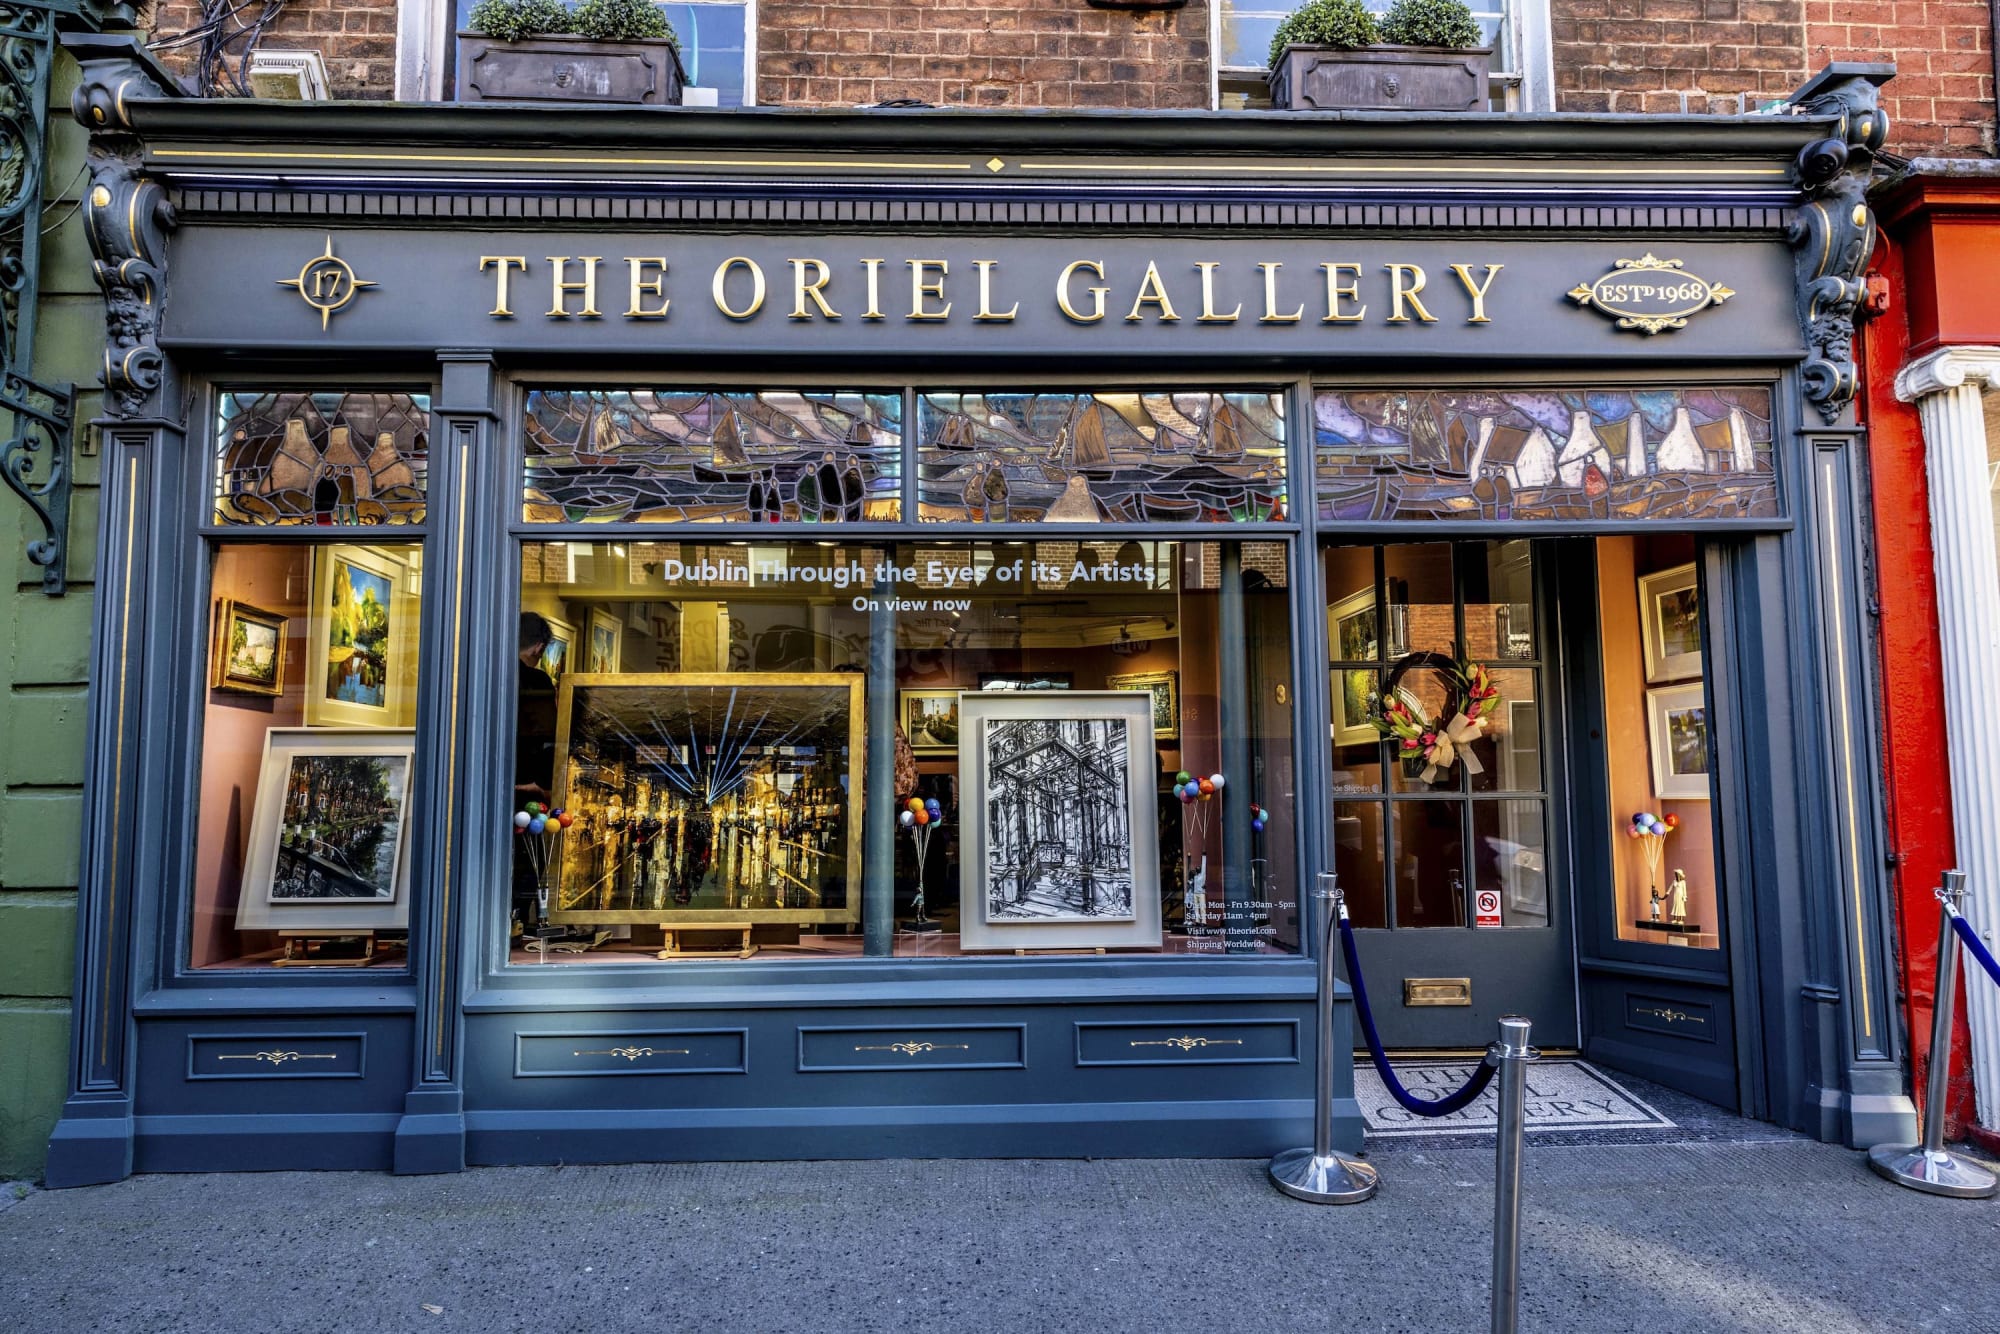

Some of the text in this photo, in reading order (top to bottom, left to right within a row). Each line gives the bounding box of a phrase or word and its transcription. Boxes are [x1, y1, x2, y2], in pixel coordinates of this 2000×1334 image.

[311, 269, 342, 298] 17
[479, 255, 1505, 323] THE ORIEL GALLERY
[1657, 282, 1704, 304] 1968
[664, 558, 1156, 589] Dublin Through the Eyes of its Artists
[852, 596, 972, 612] On view now
[1208, 901, 1225, 909] Mon
[1243, 901, 1273, 909] 9.30am
[1279, 901, 1296, 910] 5pm
[1223, 912, 1244, 920] 11am
[1249, 912, 1268, 921] 4pm
[1187, 927, 1277, 935] Visit www.theoriel.com
[1186, 940, 1266, 950] Shipping Worldwide
[1406, 1069, 1484, 1085] TH
